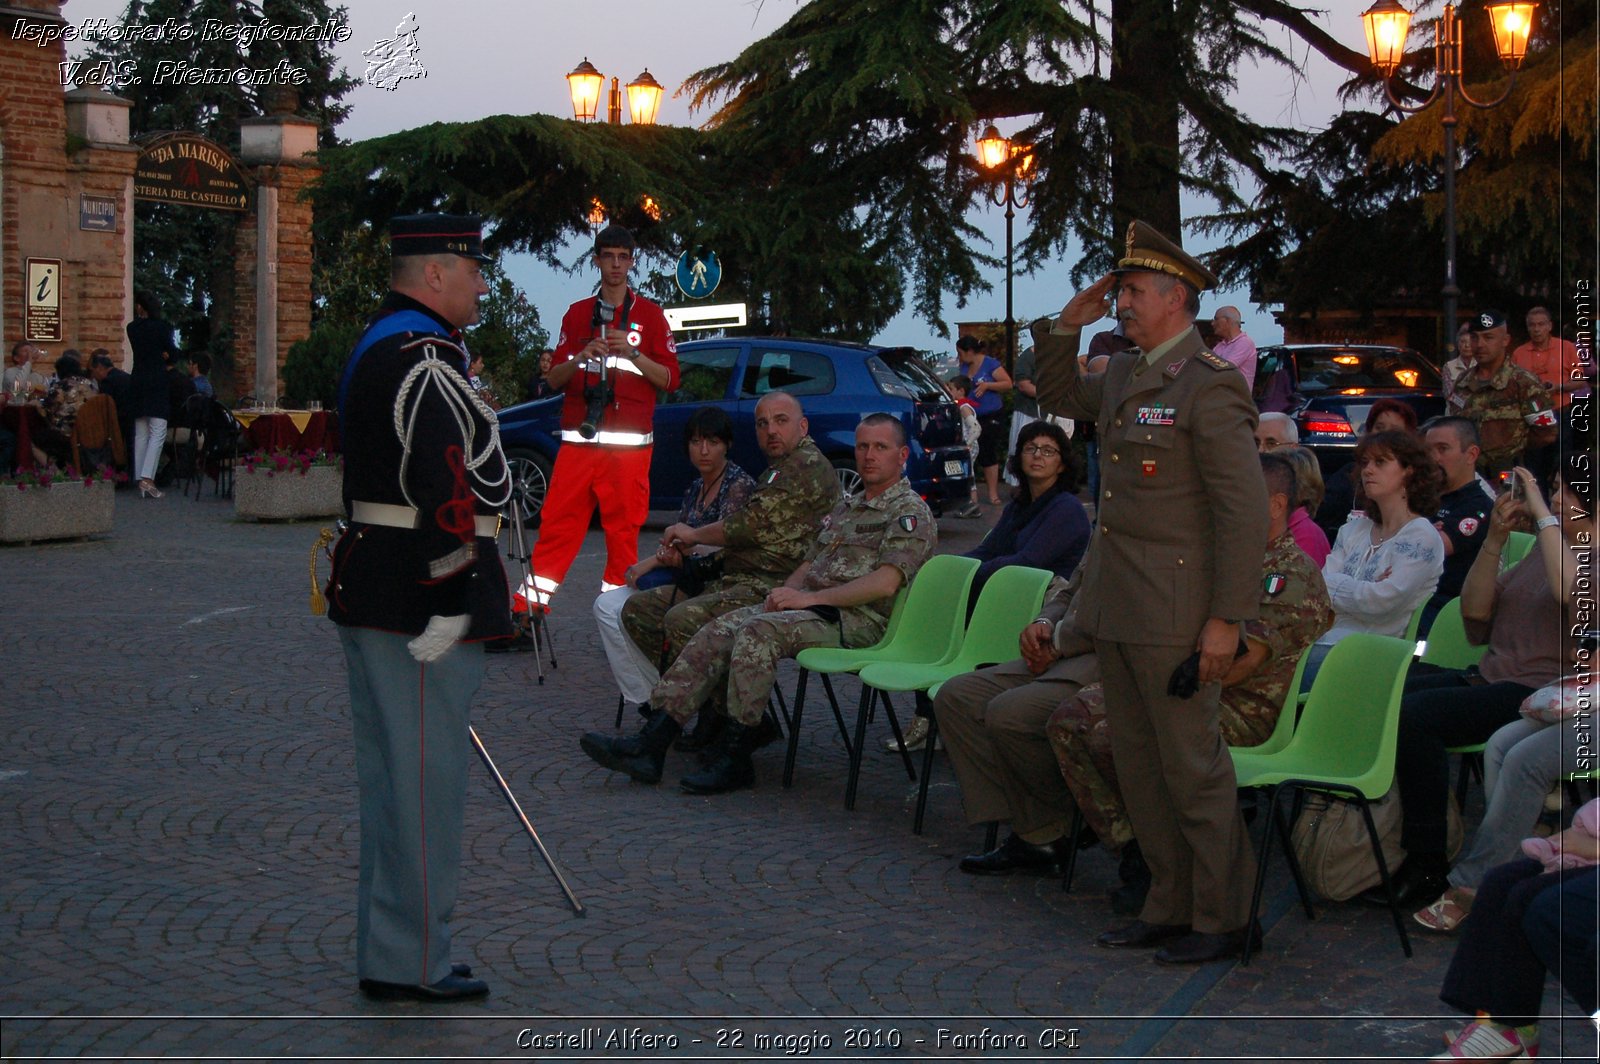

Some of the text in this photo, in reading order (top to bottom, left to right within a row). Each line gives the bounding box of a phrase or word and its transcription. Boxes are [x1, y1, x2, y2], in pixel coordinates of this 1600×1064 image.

[150, 143, 231, 174] "DA MARISA"
[134, 184, 238, 205] STERIA DEL CASTELLO
[83, 199, 115, 217] MUNICIPIO
